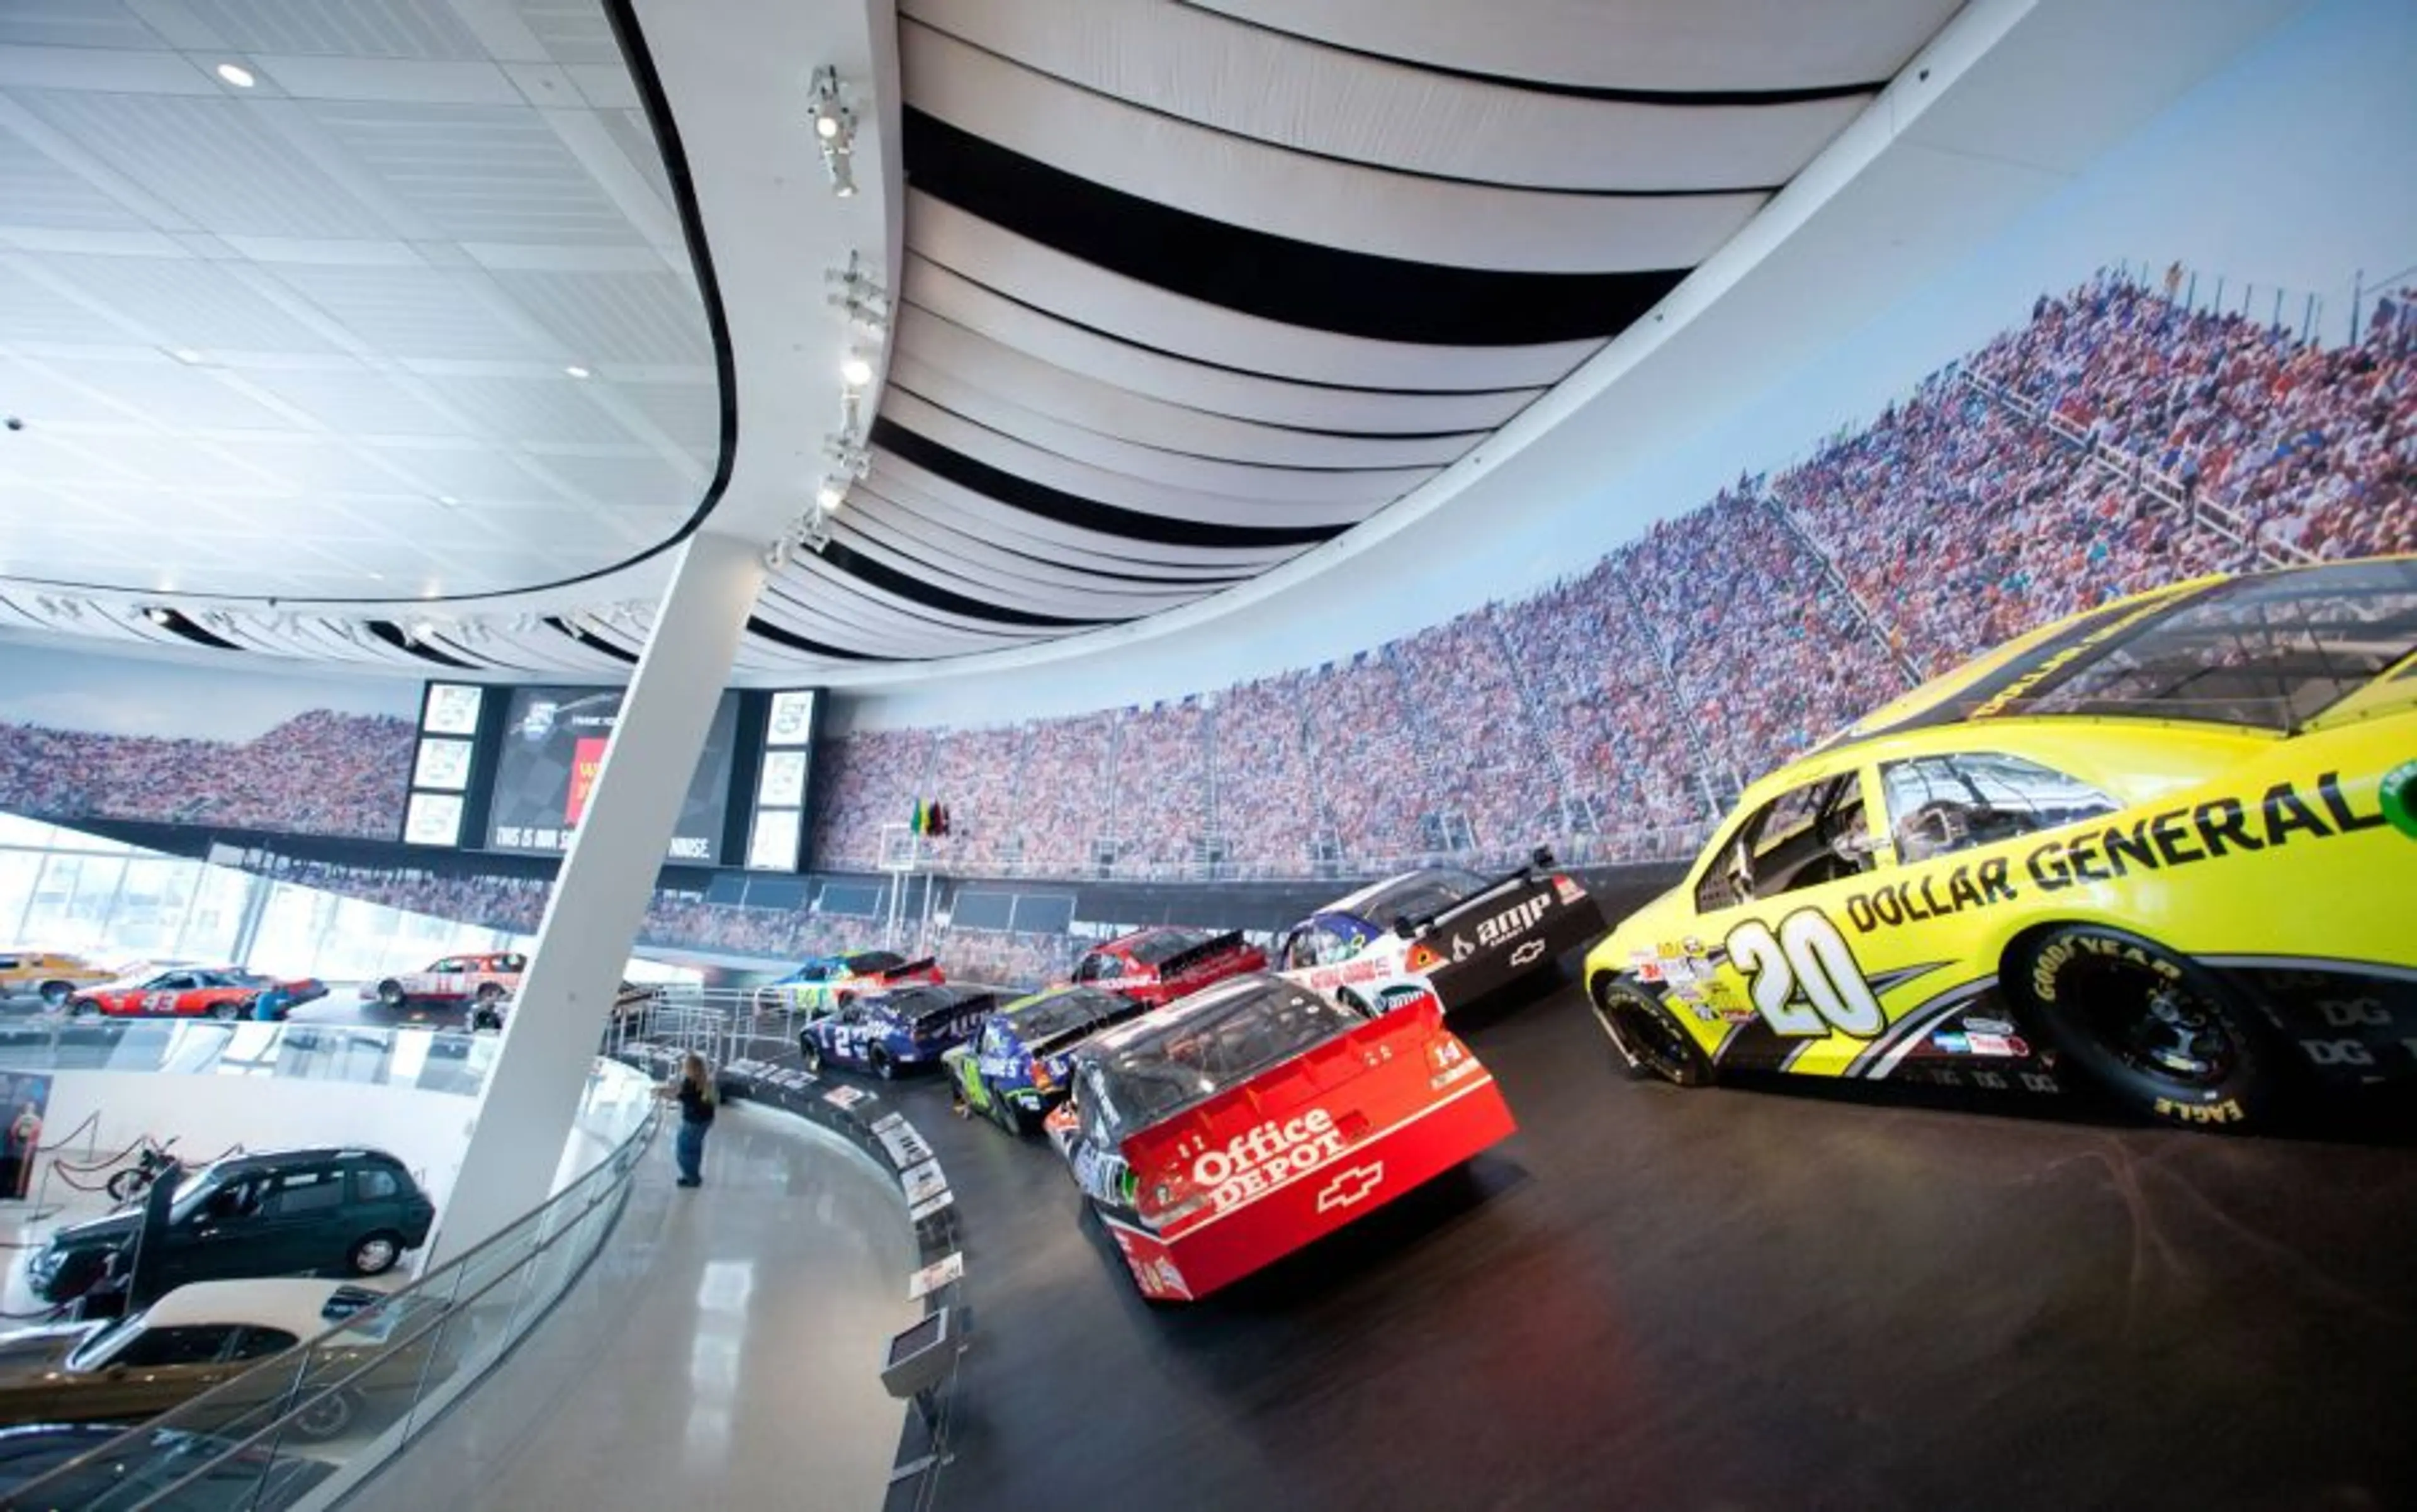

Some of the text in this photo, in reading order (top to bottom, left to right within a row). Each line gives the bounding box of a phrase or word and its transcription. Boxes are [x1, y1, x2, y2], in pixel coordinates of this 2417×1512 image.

[1846, 770, 2387, 934] DOLLAR GENERAL
[1477, 893, 1552, 946] amp
[1724, 905, 1889, 1040] 20
[2316, 998, 2392, 1026] DG
[2299, 1040, 2376, 1064] DG
[1193, 1108, 1334, 1186] Office
[1208, 1128, 1347, 1212] DEPOT
